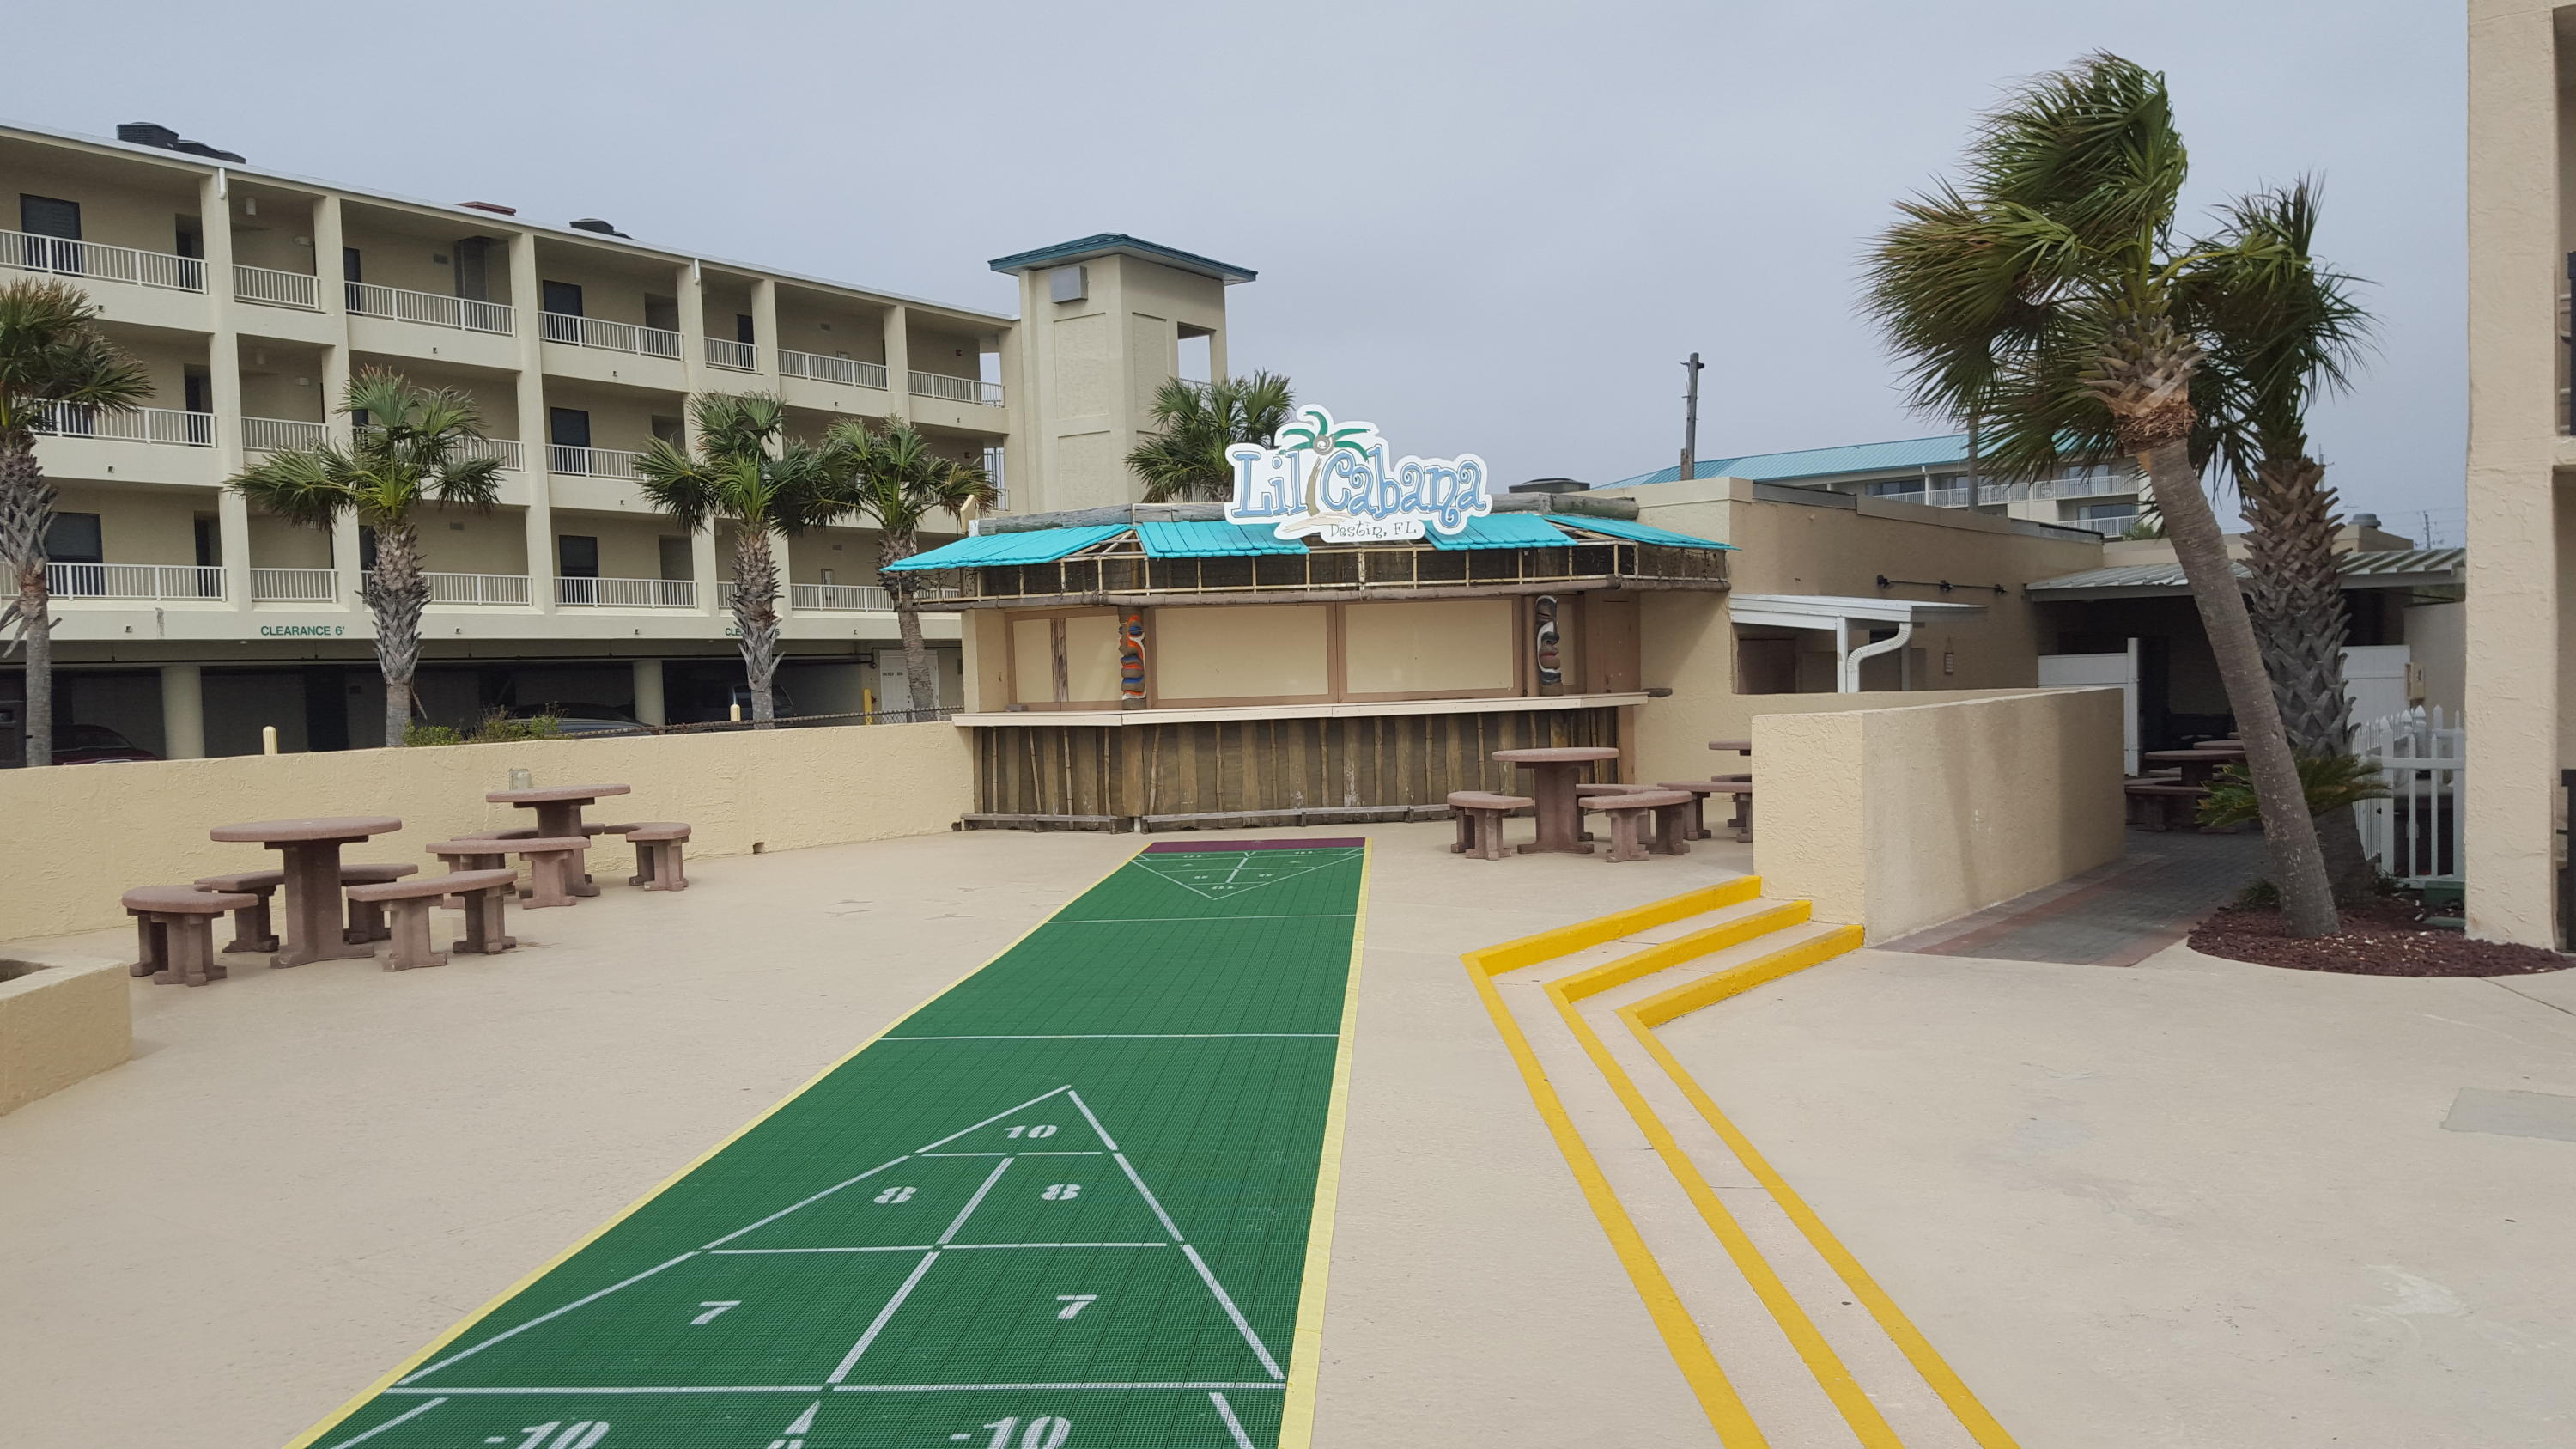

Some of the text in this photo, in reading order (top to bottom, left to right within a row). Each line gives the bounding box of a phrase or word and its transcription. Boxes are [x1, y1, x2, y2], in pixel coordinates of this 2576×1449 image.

[1320, 443, 1486, 528] Cabana
[1331, 521, 1417, 539] Destin, FL
[260, 625, 331, 636] CLEARANCE
[1004, 1125, 1058, 1139] 10
[873, 1186, 917, 1204] 8
[1041, 1184, 1082, 1201] 8
[690, 1300, 742, 1325] 7
[1055, 1294, 1097, 1320] 7
